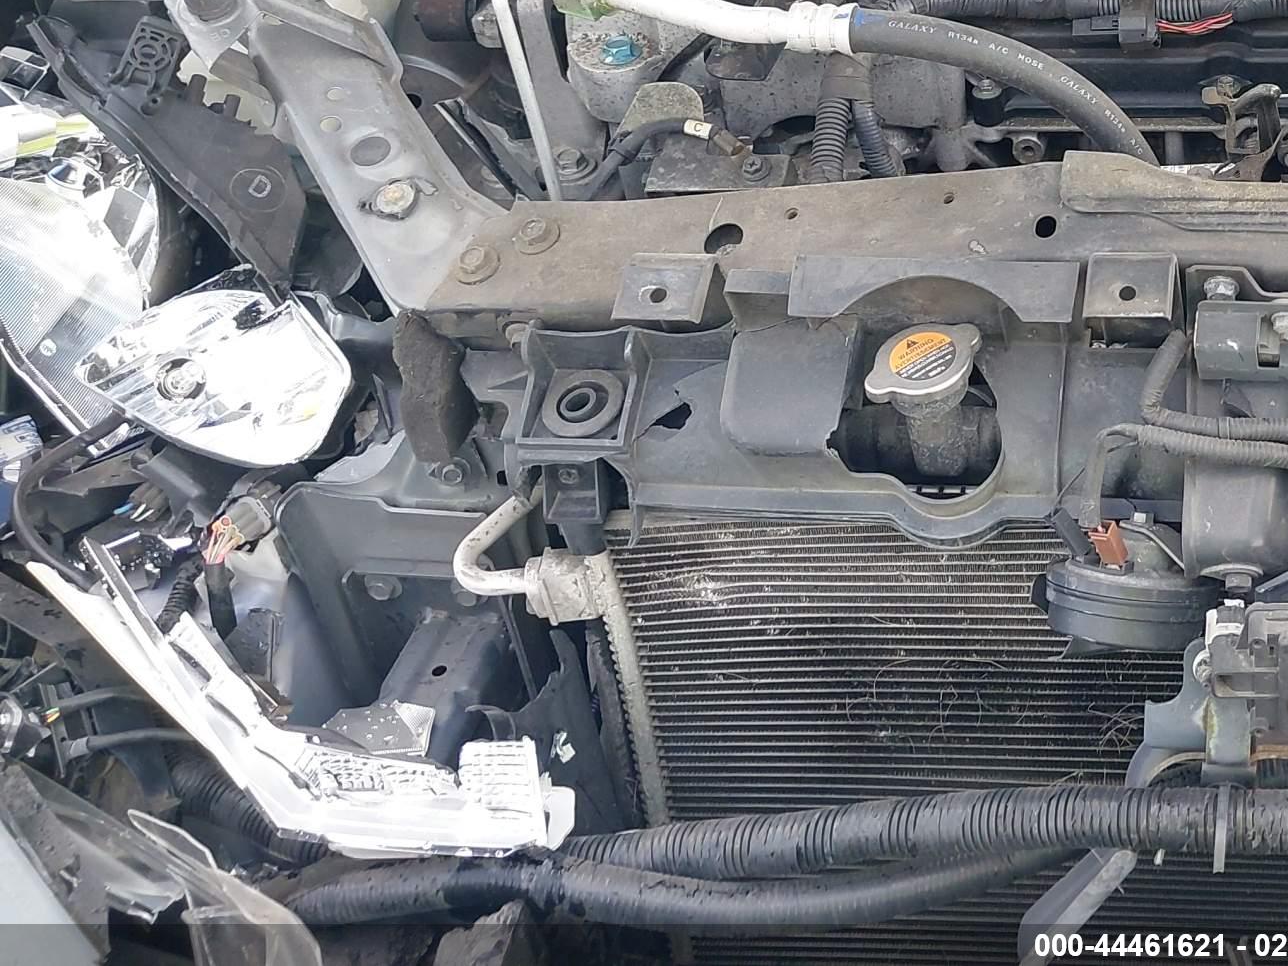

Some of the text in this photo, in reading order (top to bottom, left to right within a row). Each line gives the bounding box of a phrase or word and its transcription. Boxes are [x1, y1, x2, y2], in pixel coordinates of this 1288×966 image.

[887, 19, 1046, 71] GALAXY R134a A/C HOSE
[693, 122, 703, 132] C
[1060, 75, 1098, 106] GALAXY
[1128, 137, 1144, 156] A/C
[248, 174, 272, 198] D
[899, 338, 934, 360] WARNING
